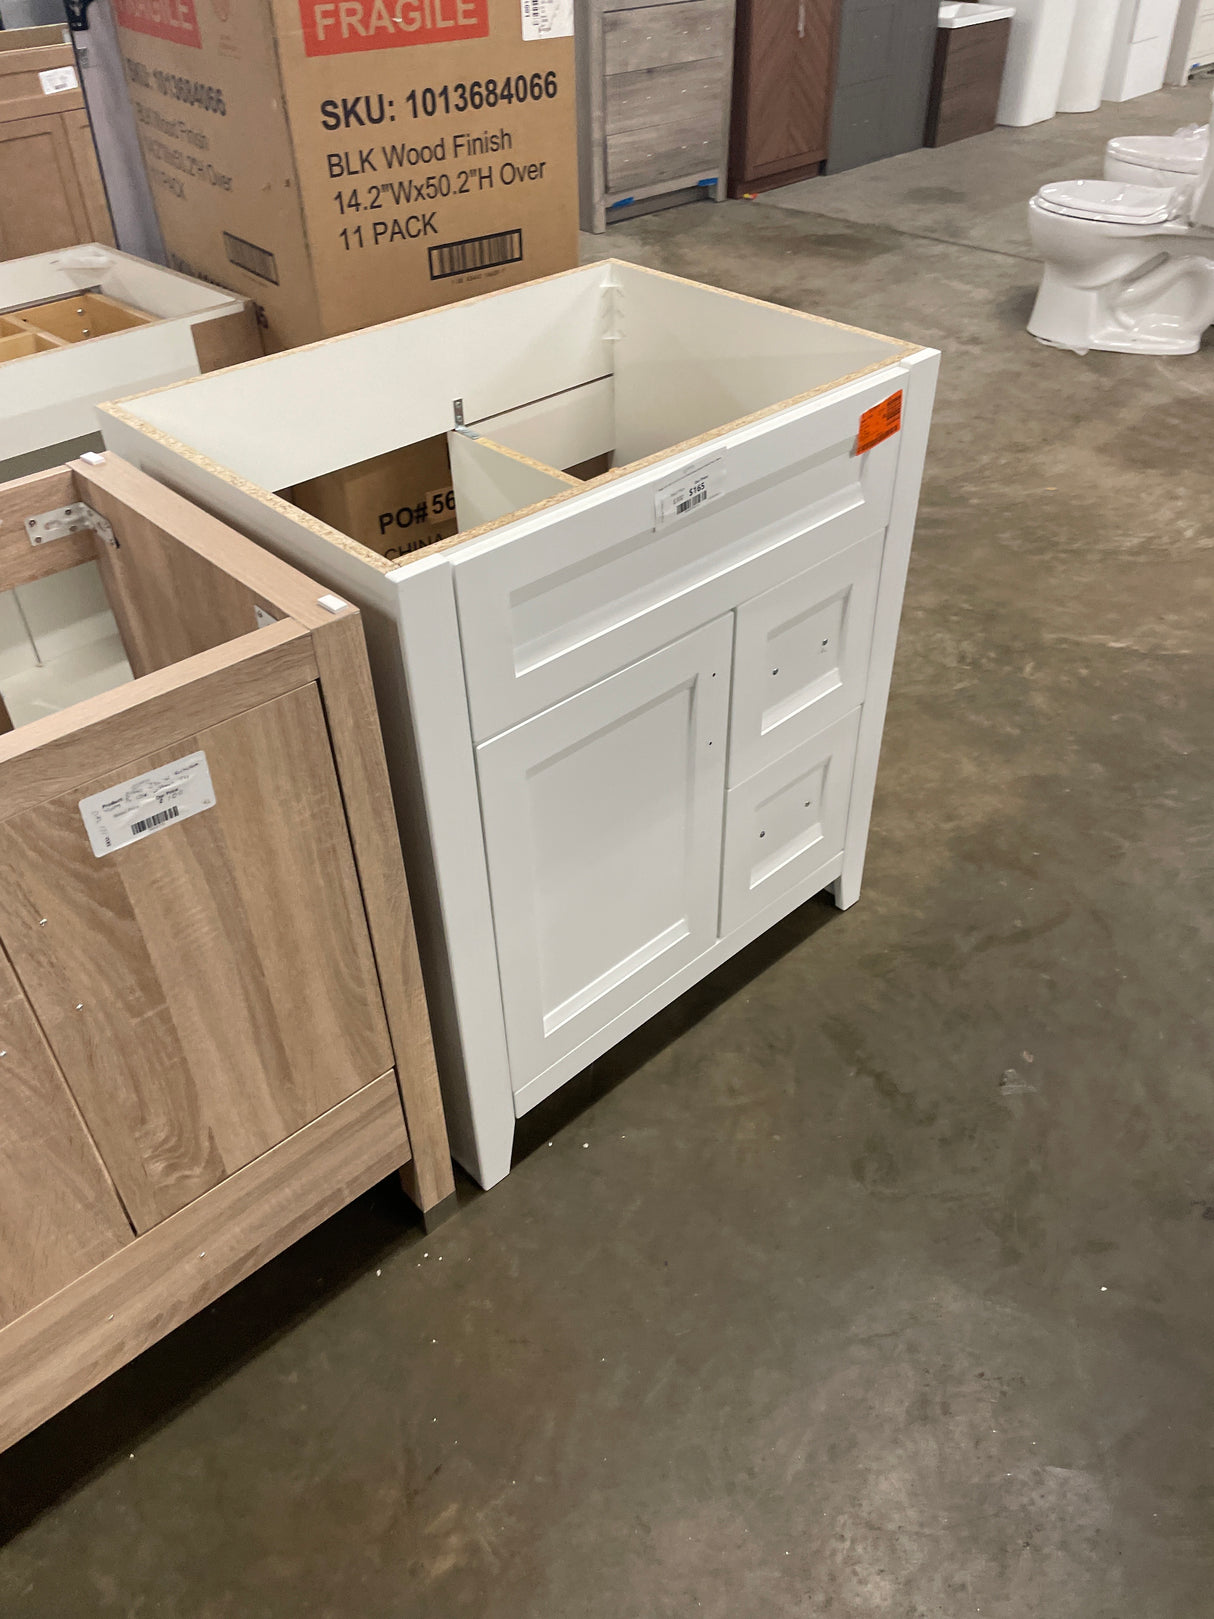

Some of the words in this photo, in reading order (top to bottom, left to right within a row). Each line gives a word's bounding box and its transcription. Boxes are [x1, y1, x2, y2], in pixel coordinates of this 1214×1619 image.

[314, 0, 479, 41] FRAGILE
[320, 93, 396, 131] SKU:
[405, 71, 558, 119] 1013684066
[327, 147, 378, 178] BLK
[383, 138, 446, 169] Wood
[453, 128, 513, 158] Finish
[500, 161, 547, 185] Over
[339, 225, 364, 250] 11
[372, 211, 439, 245] PACK
[378, 501, 428, 535] PO#
